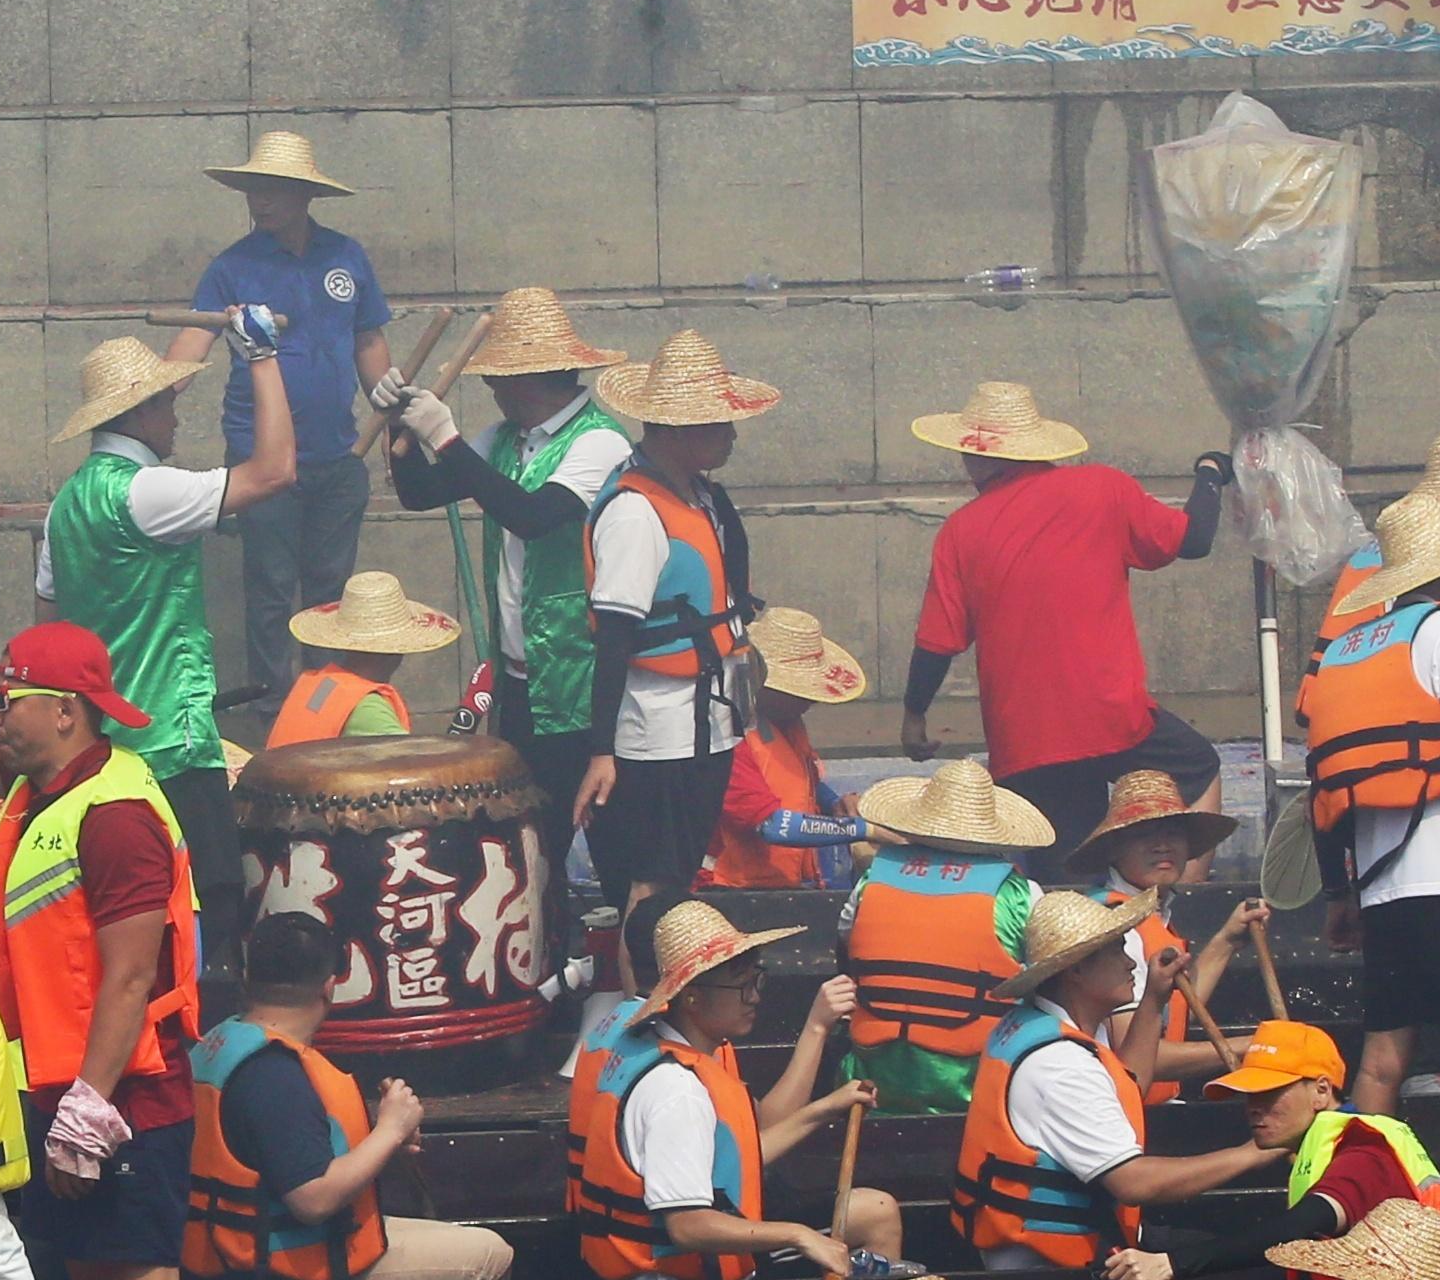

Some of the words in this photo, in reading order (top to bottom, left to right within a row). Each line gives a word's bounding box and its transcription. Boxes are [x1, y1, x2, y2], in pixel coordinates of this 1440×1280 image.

[778, 809, 790, 837] AMD
[32, 831, 63, 851] 大北
[377, 829, 456, 1011] 天河區
